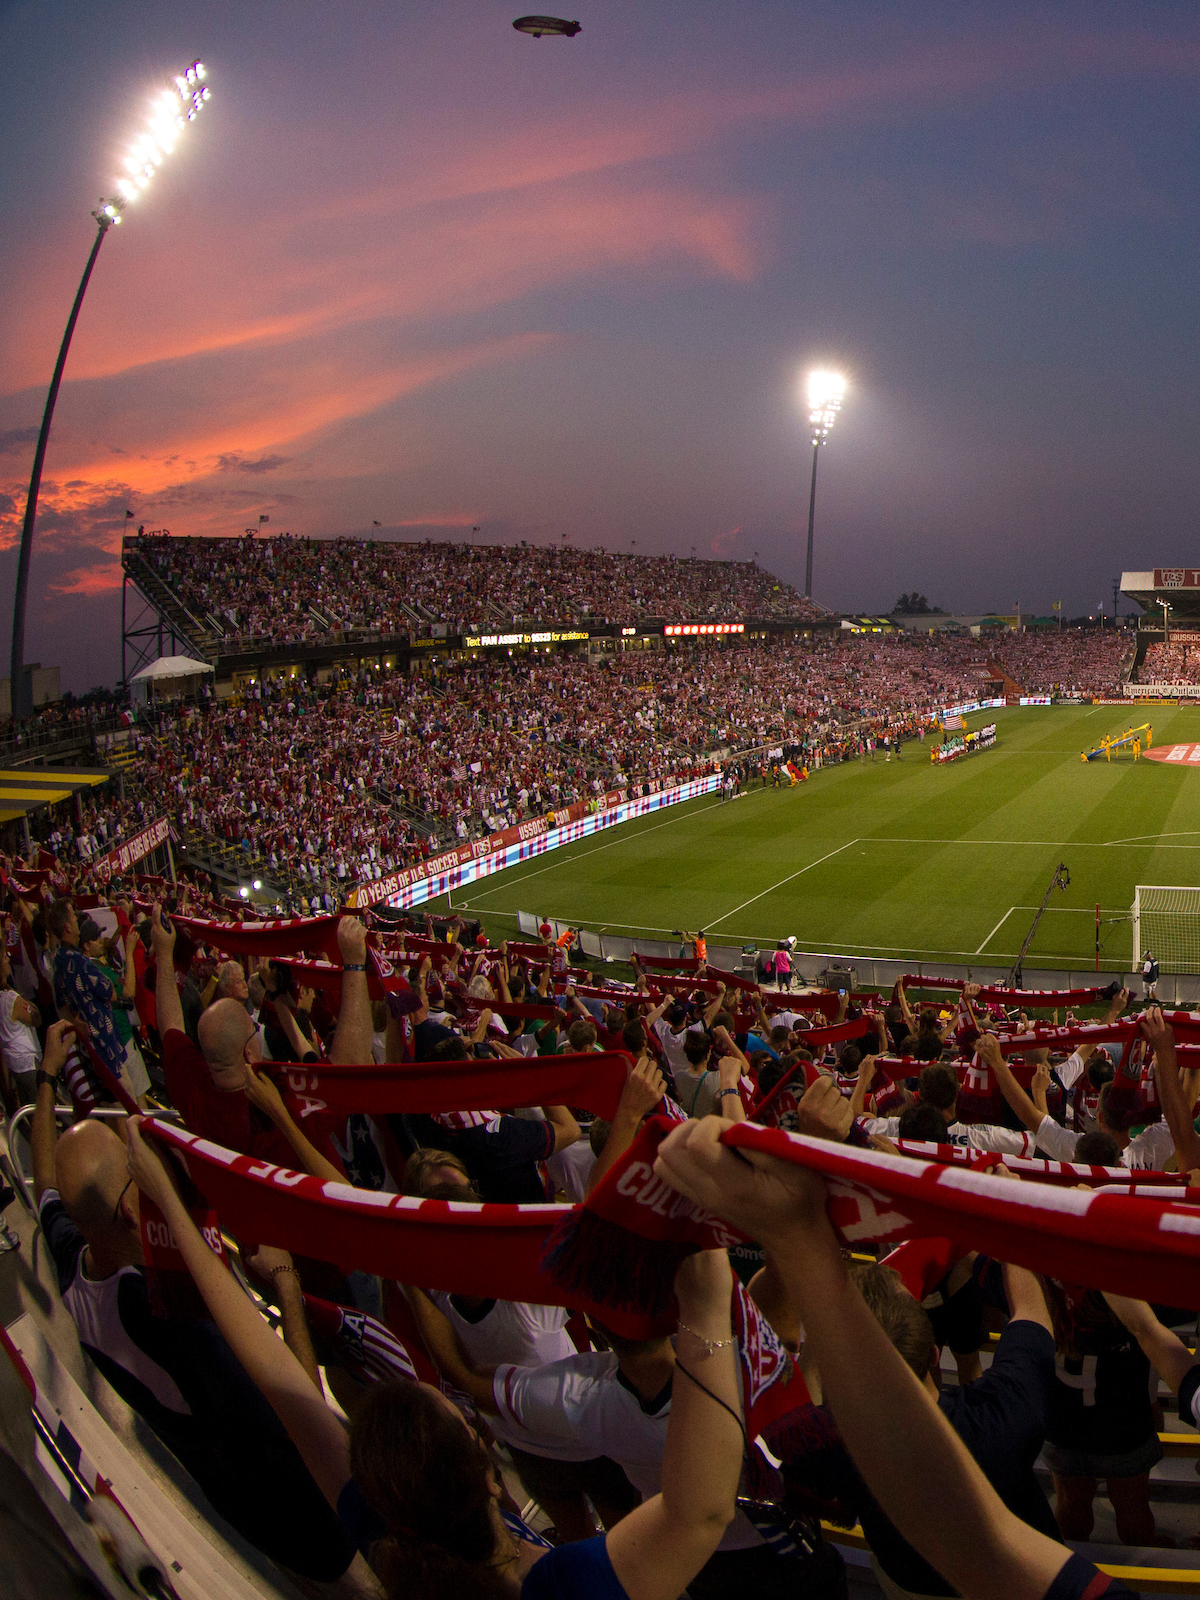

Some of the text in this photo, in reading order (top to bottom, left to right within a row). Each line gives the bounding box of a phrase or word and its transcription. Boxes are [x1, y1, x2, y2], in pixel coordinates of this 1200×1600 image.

[466, 637, 480, 647] Text
[481, 636, 497, 646] FAN
[498, 634, 523, 645] ASSIST
[524, 634, 531, 643] to
[552, 632, 560, 642] for
[561, 631, 589, 641] assistance
[1124, 686, 1161, 696] American
[127, 836, 145, 863] YEARS
[369, 877, 398, 901] YEARS
[398, 875, 410, 890] OF
[410, 867, 426, 883] U.S.
[426, 852, 460, 875] SOCCER
